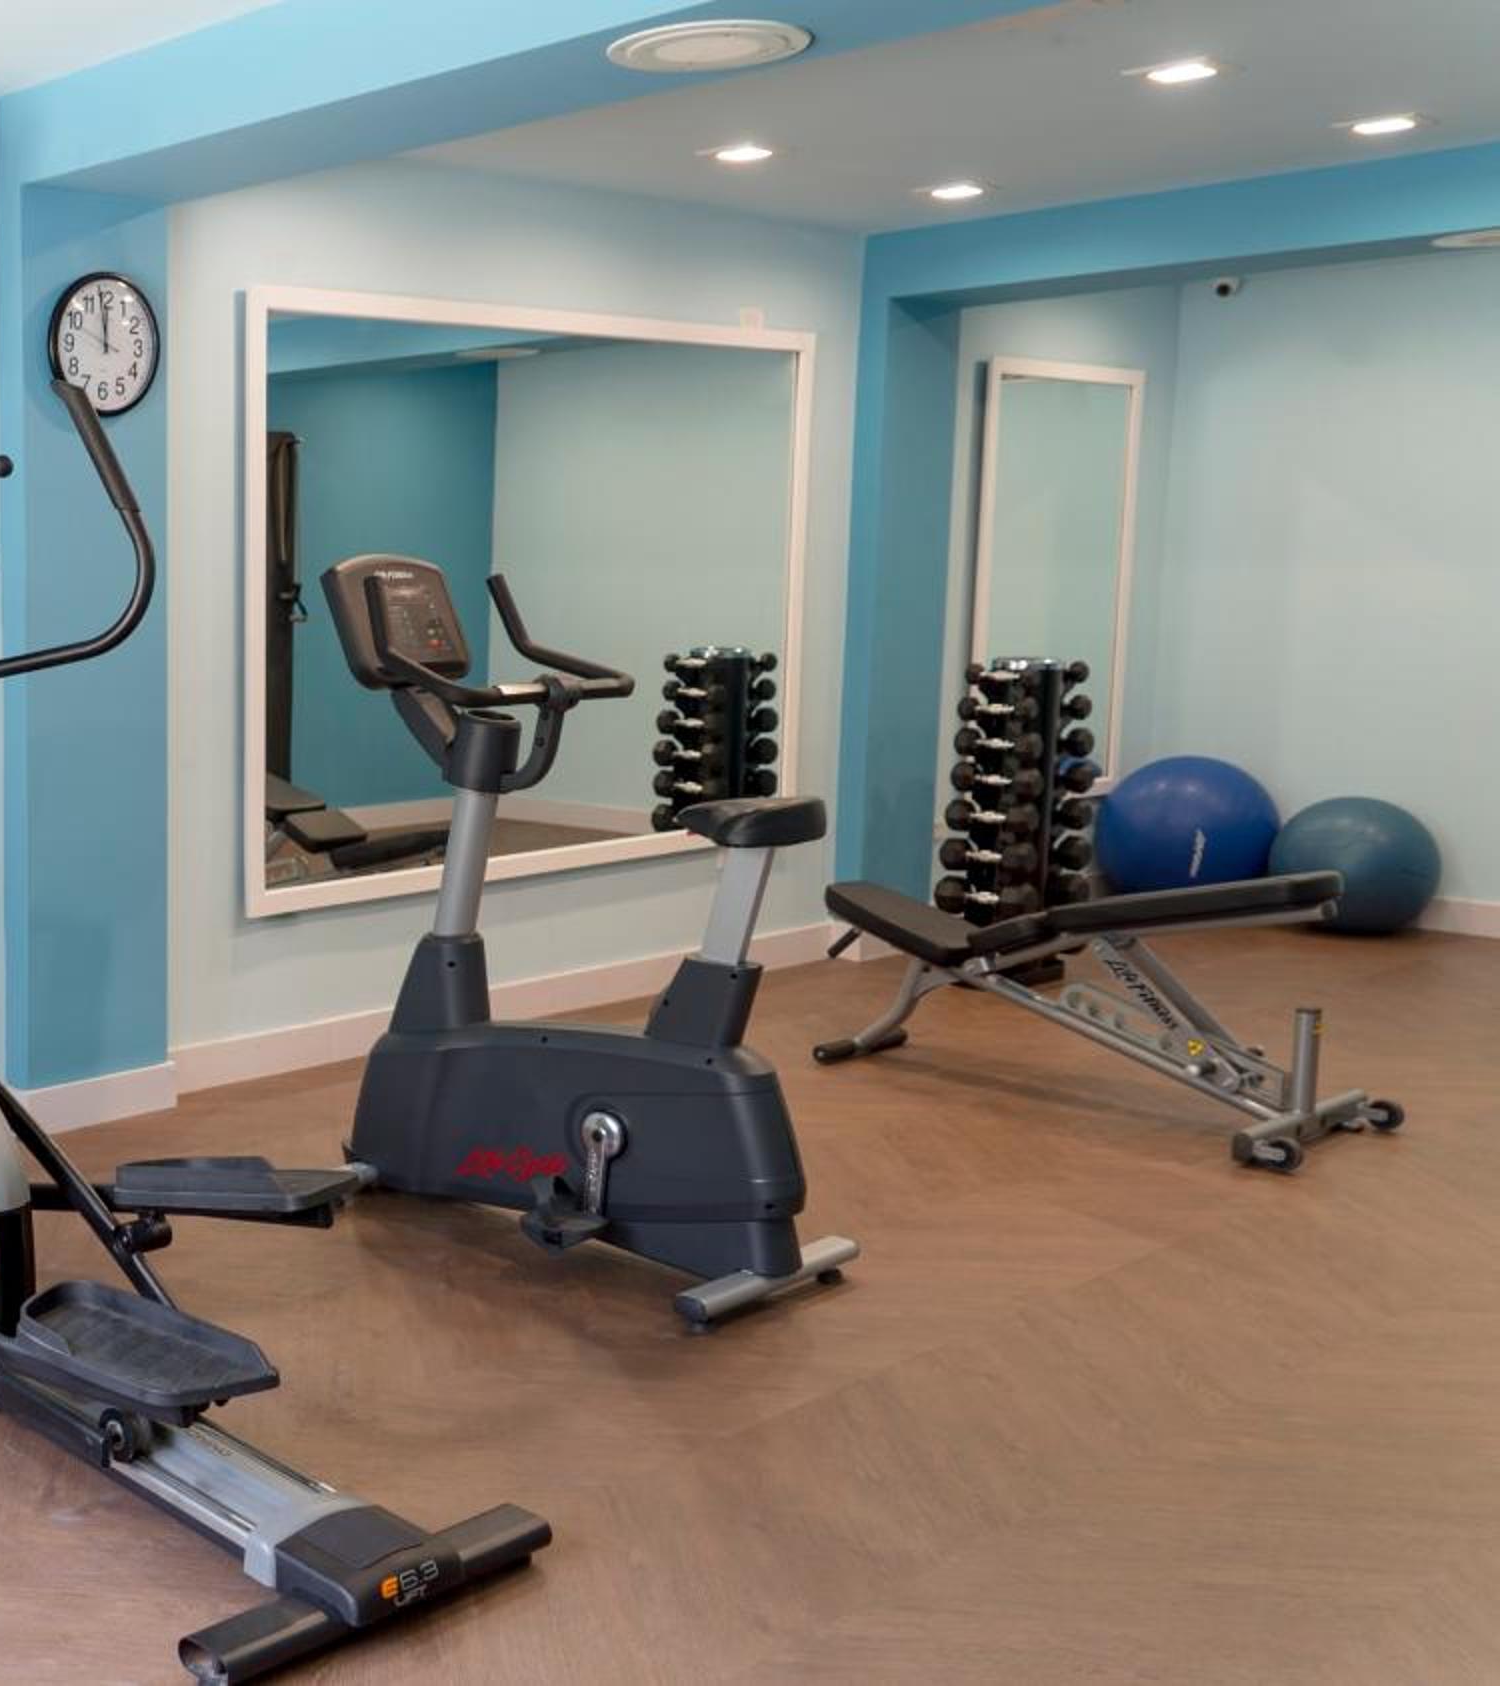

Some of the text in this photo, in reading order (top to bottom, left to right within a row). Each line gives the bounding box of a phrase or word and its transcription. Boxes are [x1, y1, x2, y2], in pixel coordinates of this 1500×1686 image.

[83, 295, 95, 314] 11
[98, 290, 115, 311] 12
[120, 300, 127, 317] 1
[67, 311, 82, 330] 10
[129, 316, 140, 335] 2
[64, 333, 75, 353] 9
[133, 339, 143, 358] 3
[68, 357, 79, 376] 8
[128, 362, 137, 380] 4
[81, 374, 91, 388] 7
[115, 376, 125, 396] 5
[98, 382, 108, 400] 6
